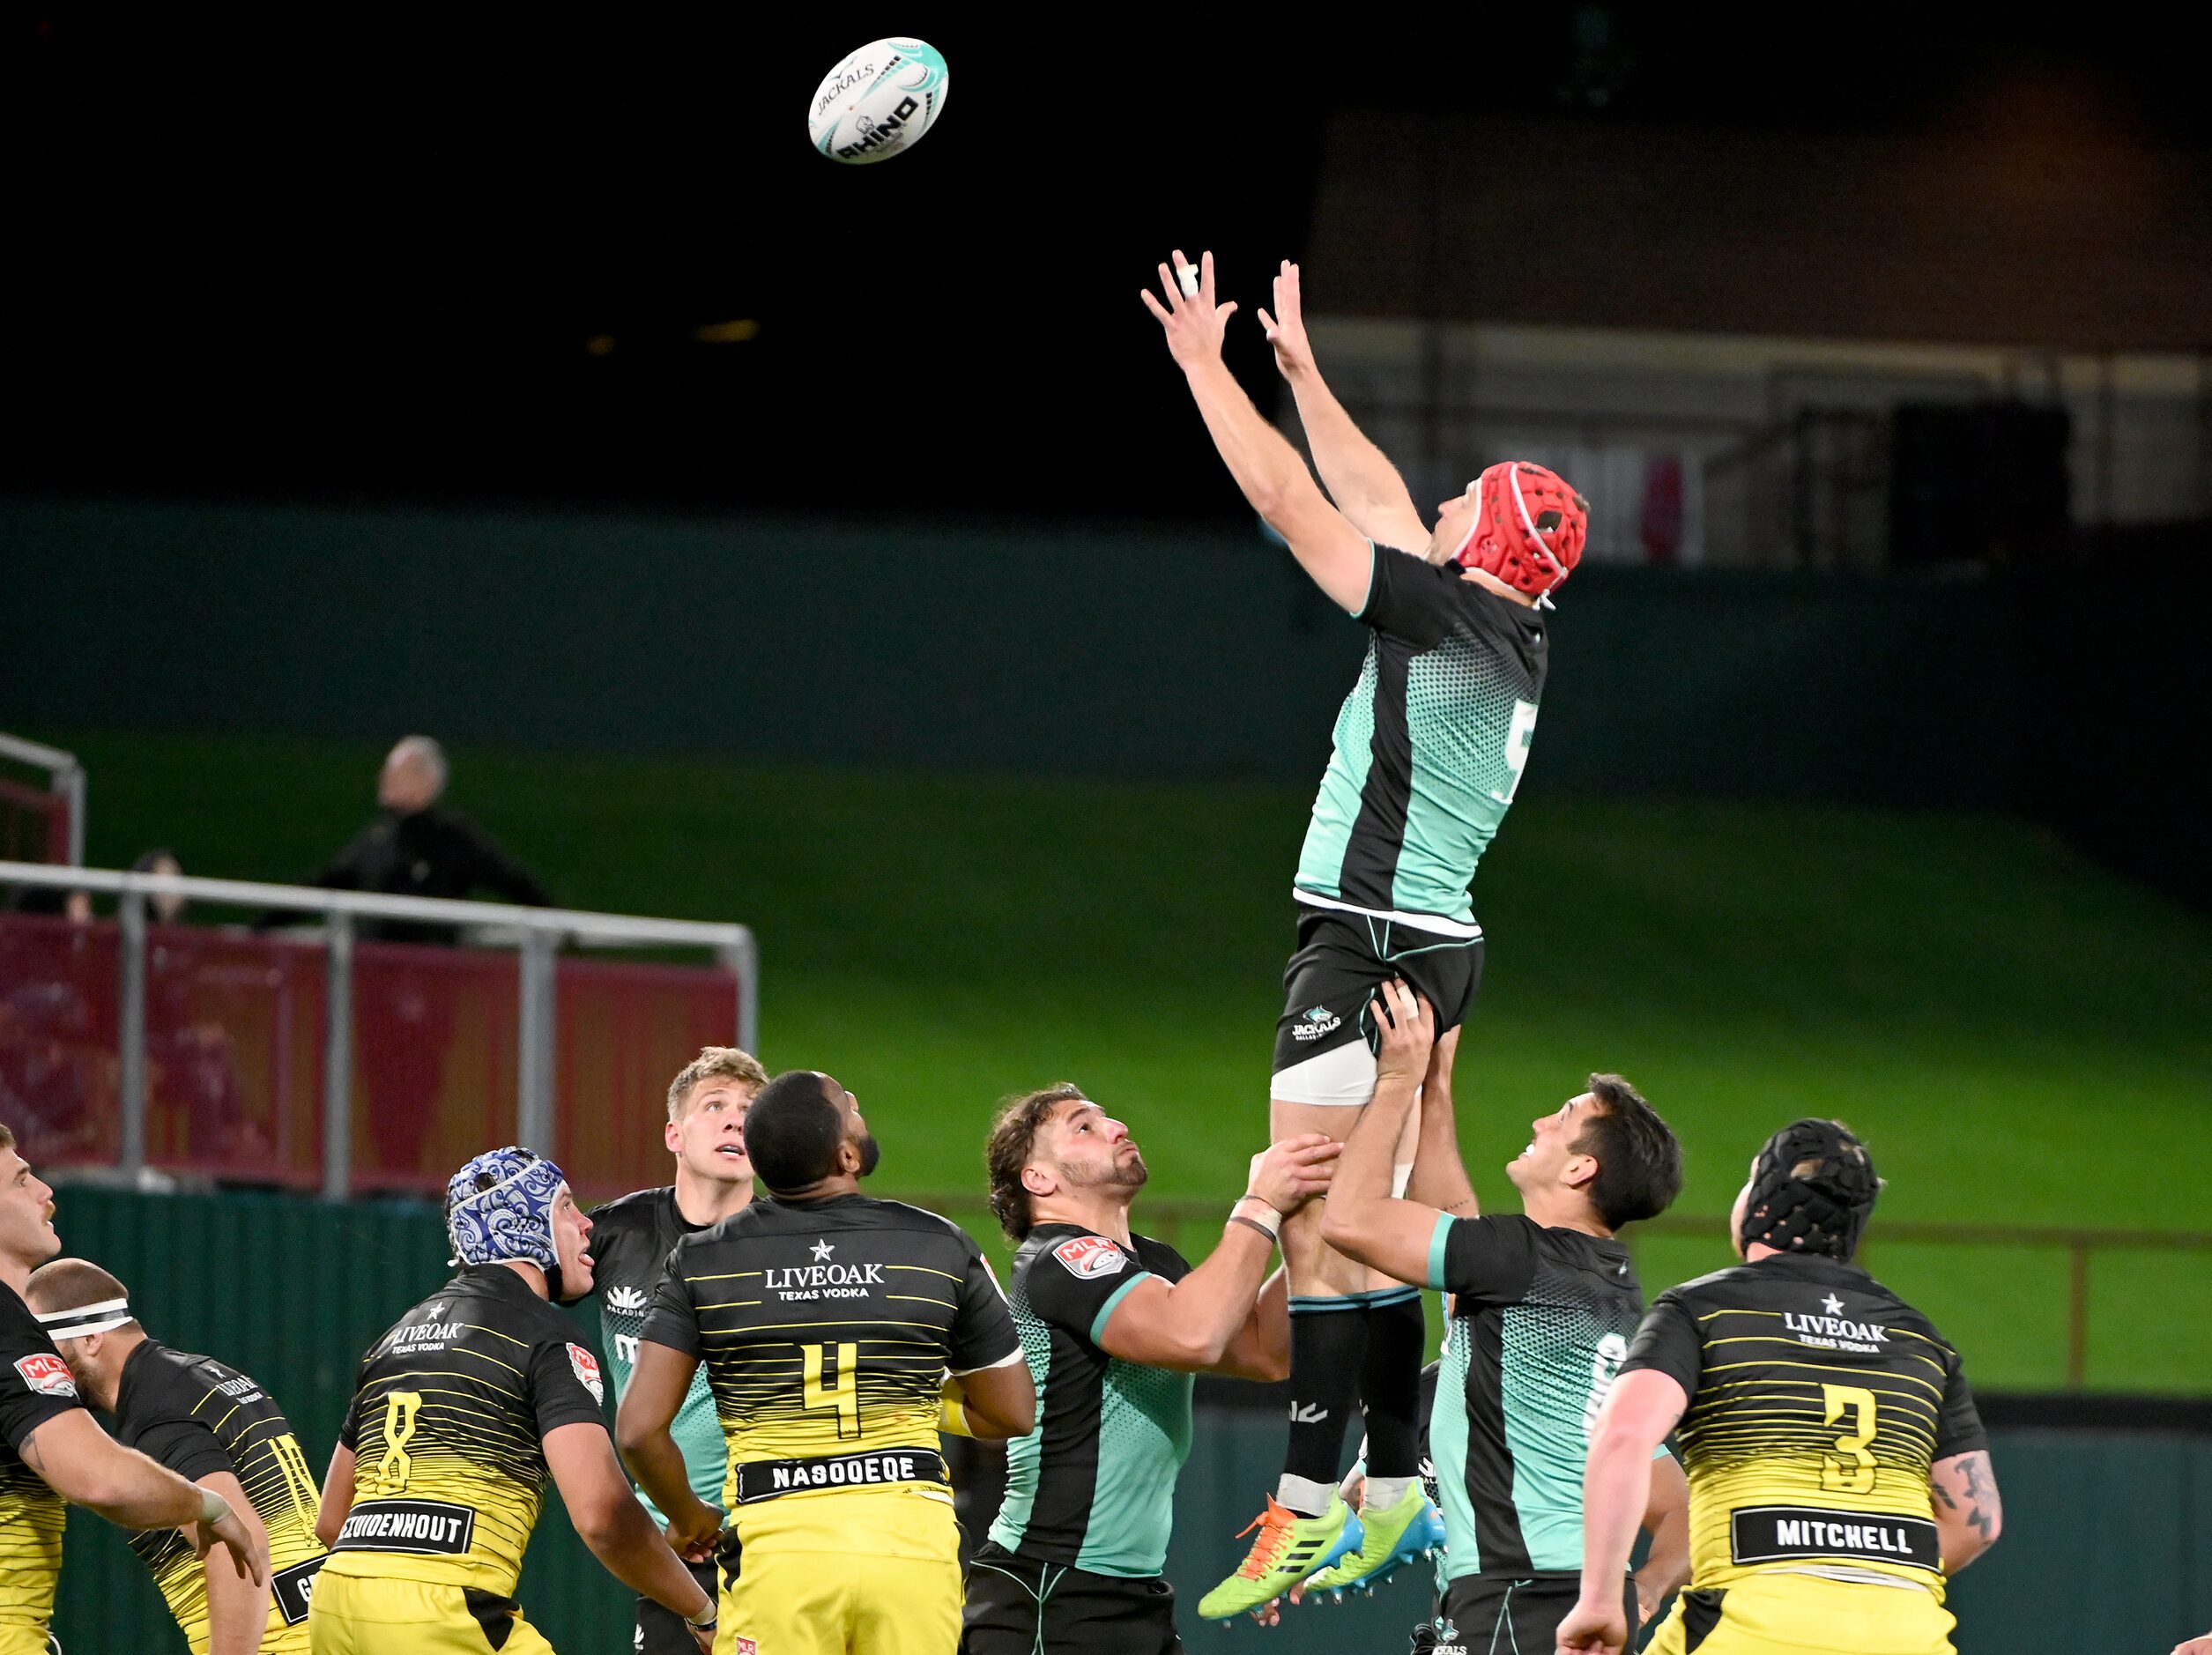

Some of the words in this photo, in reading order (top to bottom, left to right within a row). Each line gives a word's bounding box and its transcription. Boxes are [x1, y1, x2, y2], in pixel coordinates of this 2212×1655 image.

[819, 63, 875, 115] JACKALS
[836, 95, 919, 159] RHINO
[1292, 1016, 1341, 1036] JACKALS
[1062, 1238, 1113, 1260] MLR
[765, 1263, 885, 1288] LIVEOAK
[778, 1288, 820, 1301] TEXAS
[821, 1288, 870, 1298] VODKA
[606, 1304, 645, 1317] PALADIN
[390, 1322, 465, 1347] LIVEOAK
[1784, 1311, 1891, 1342] LIVEOAK
[392, 1343, 417, 1354] TEXAS
[418, 1342, 445, 1351] VODKA
[1799, 1333, 1837, 1347] TEXAS
[799, 1342, 861, 1439] 4
[374, 1392, 423, 1495] 8
[1821, 1383, 1878, 1495] 3
[1777, 1519, 1913, 1554] MITCHELL
